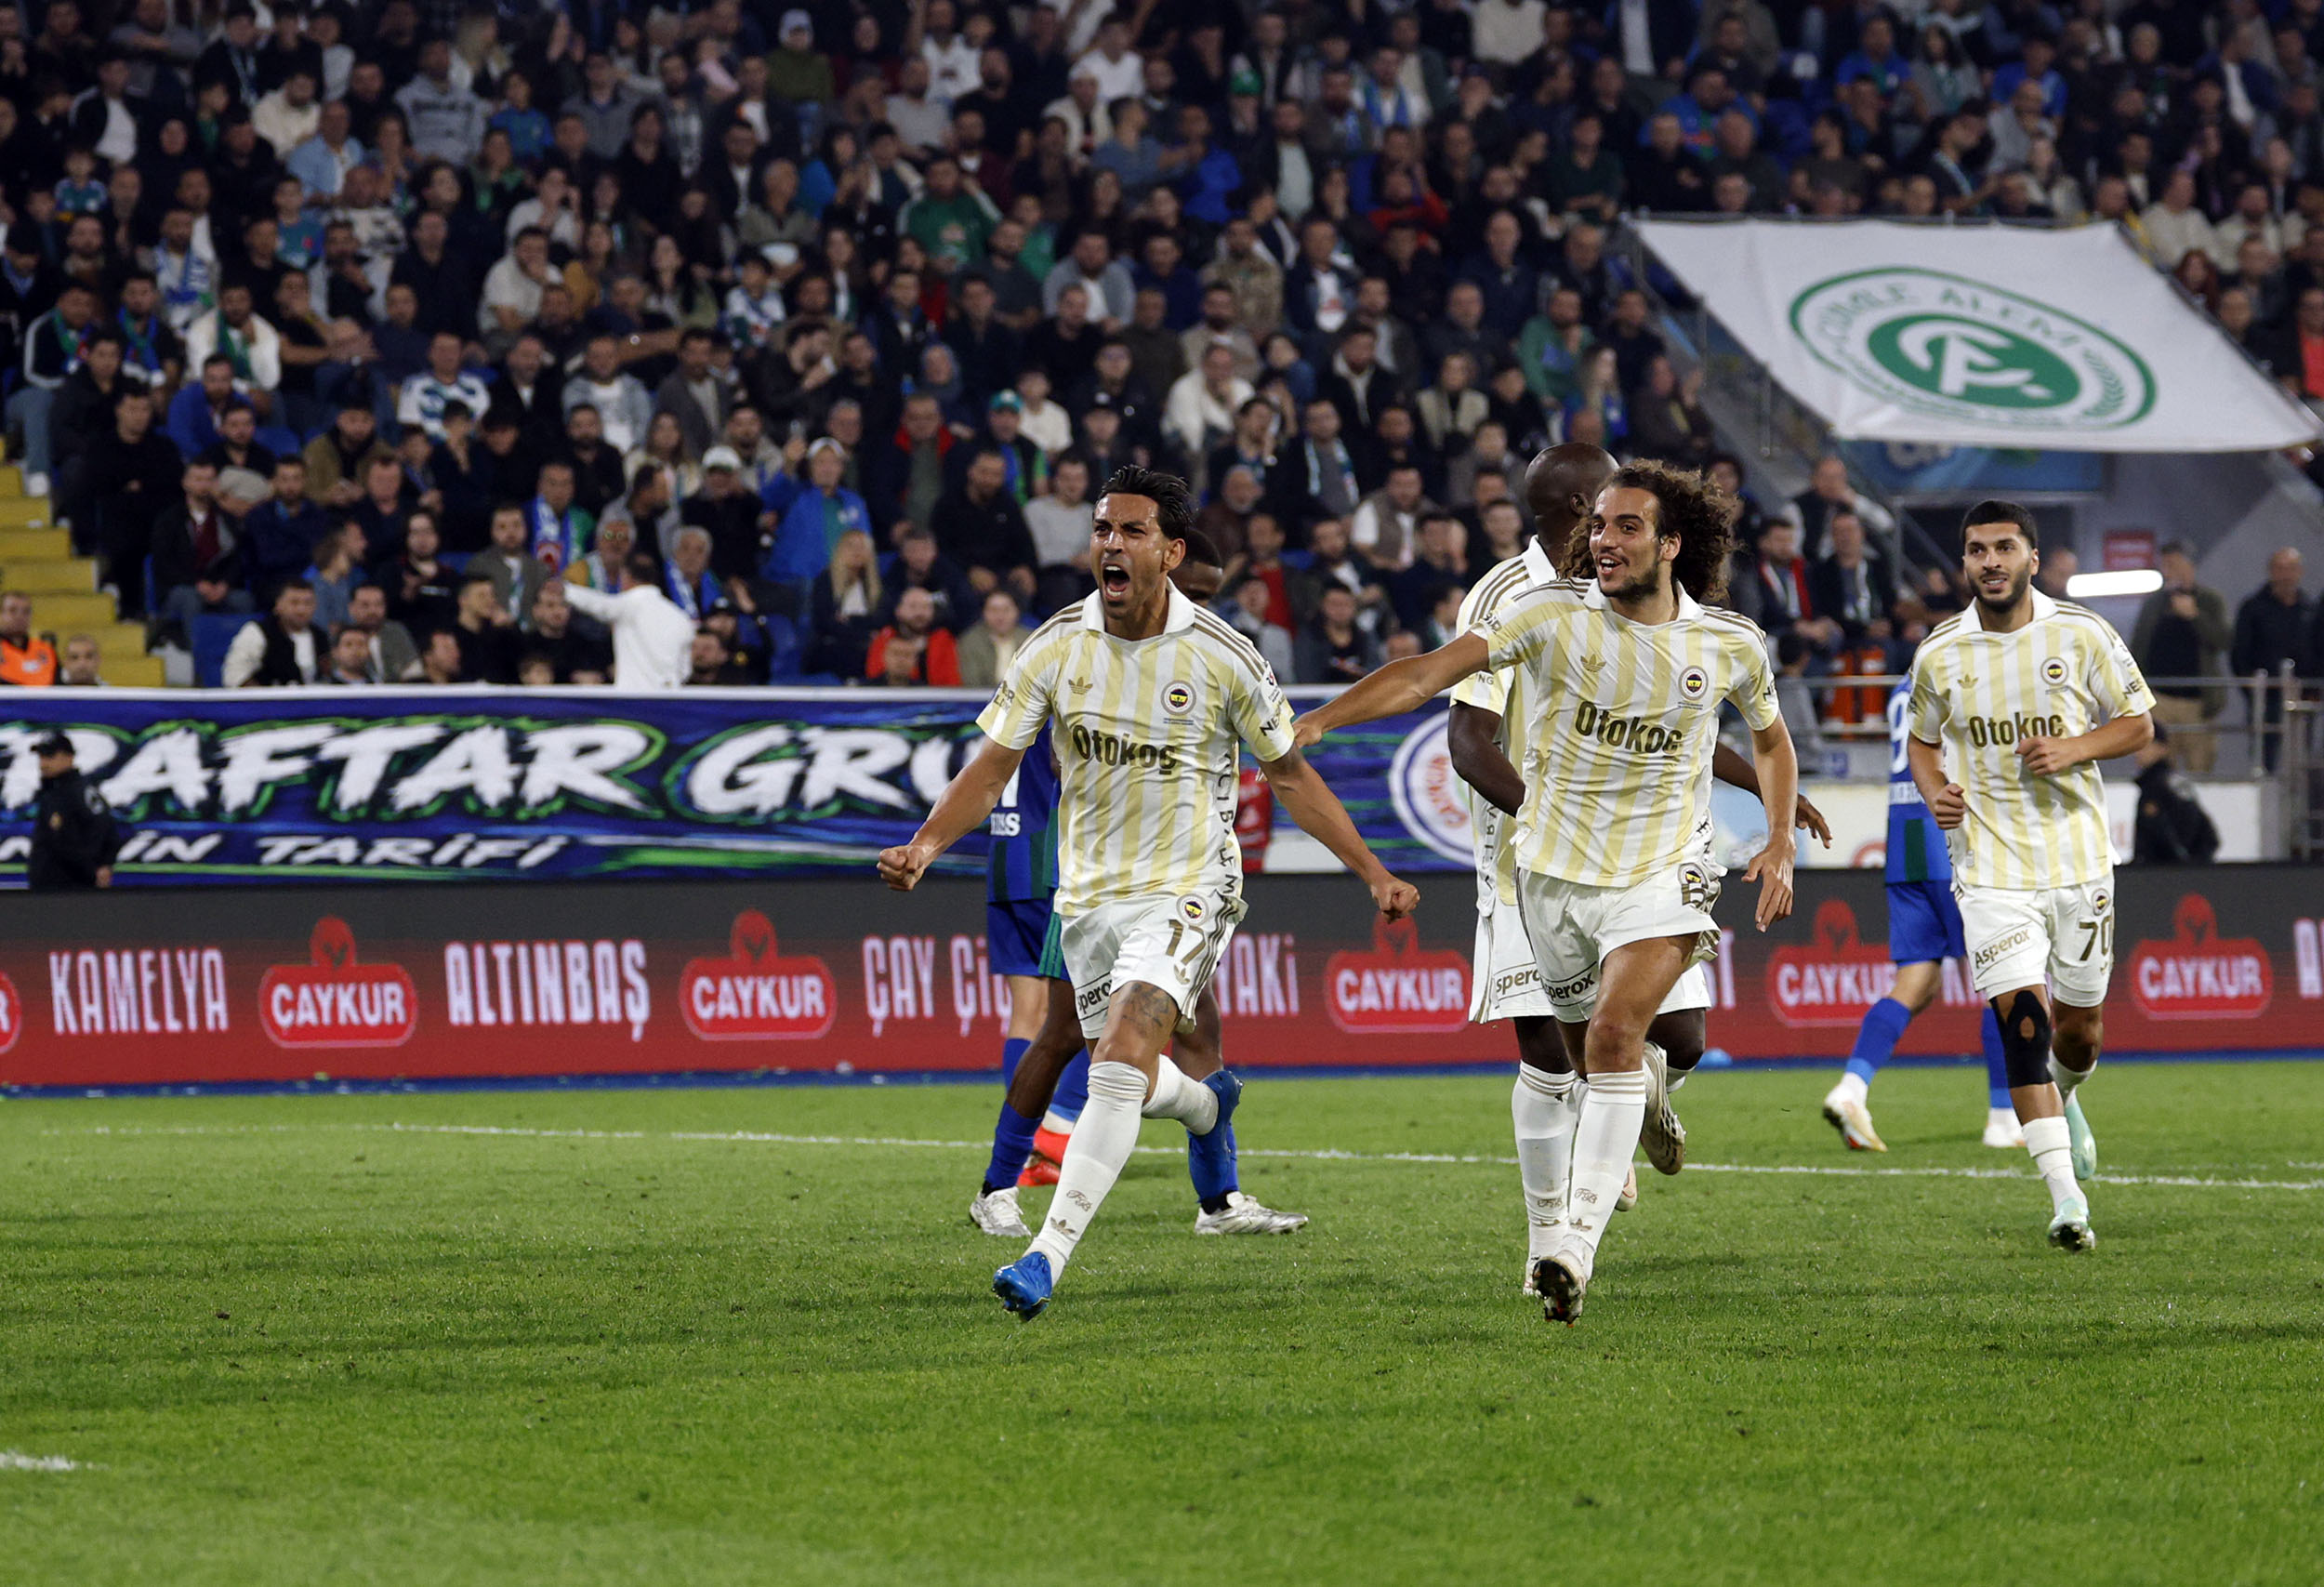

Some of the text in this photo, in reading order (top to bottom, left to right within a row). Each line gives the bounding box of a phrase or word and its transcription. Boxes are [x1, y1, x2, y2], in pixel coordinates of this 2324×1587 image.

[686, 723, 987, 815] GRU
[1166, 919, 1207, 965] 17
[1974, 929, 2030, 969] Asperox
[2079, 915, 2113, 961] 70
[49, 948, 229, 1035] KAMELYA
[445, 941, 650, 1042] ALTINBAŞ
[863, 935, 935, 1037] ÇAY
